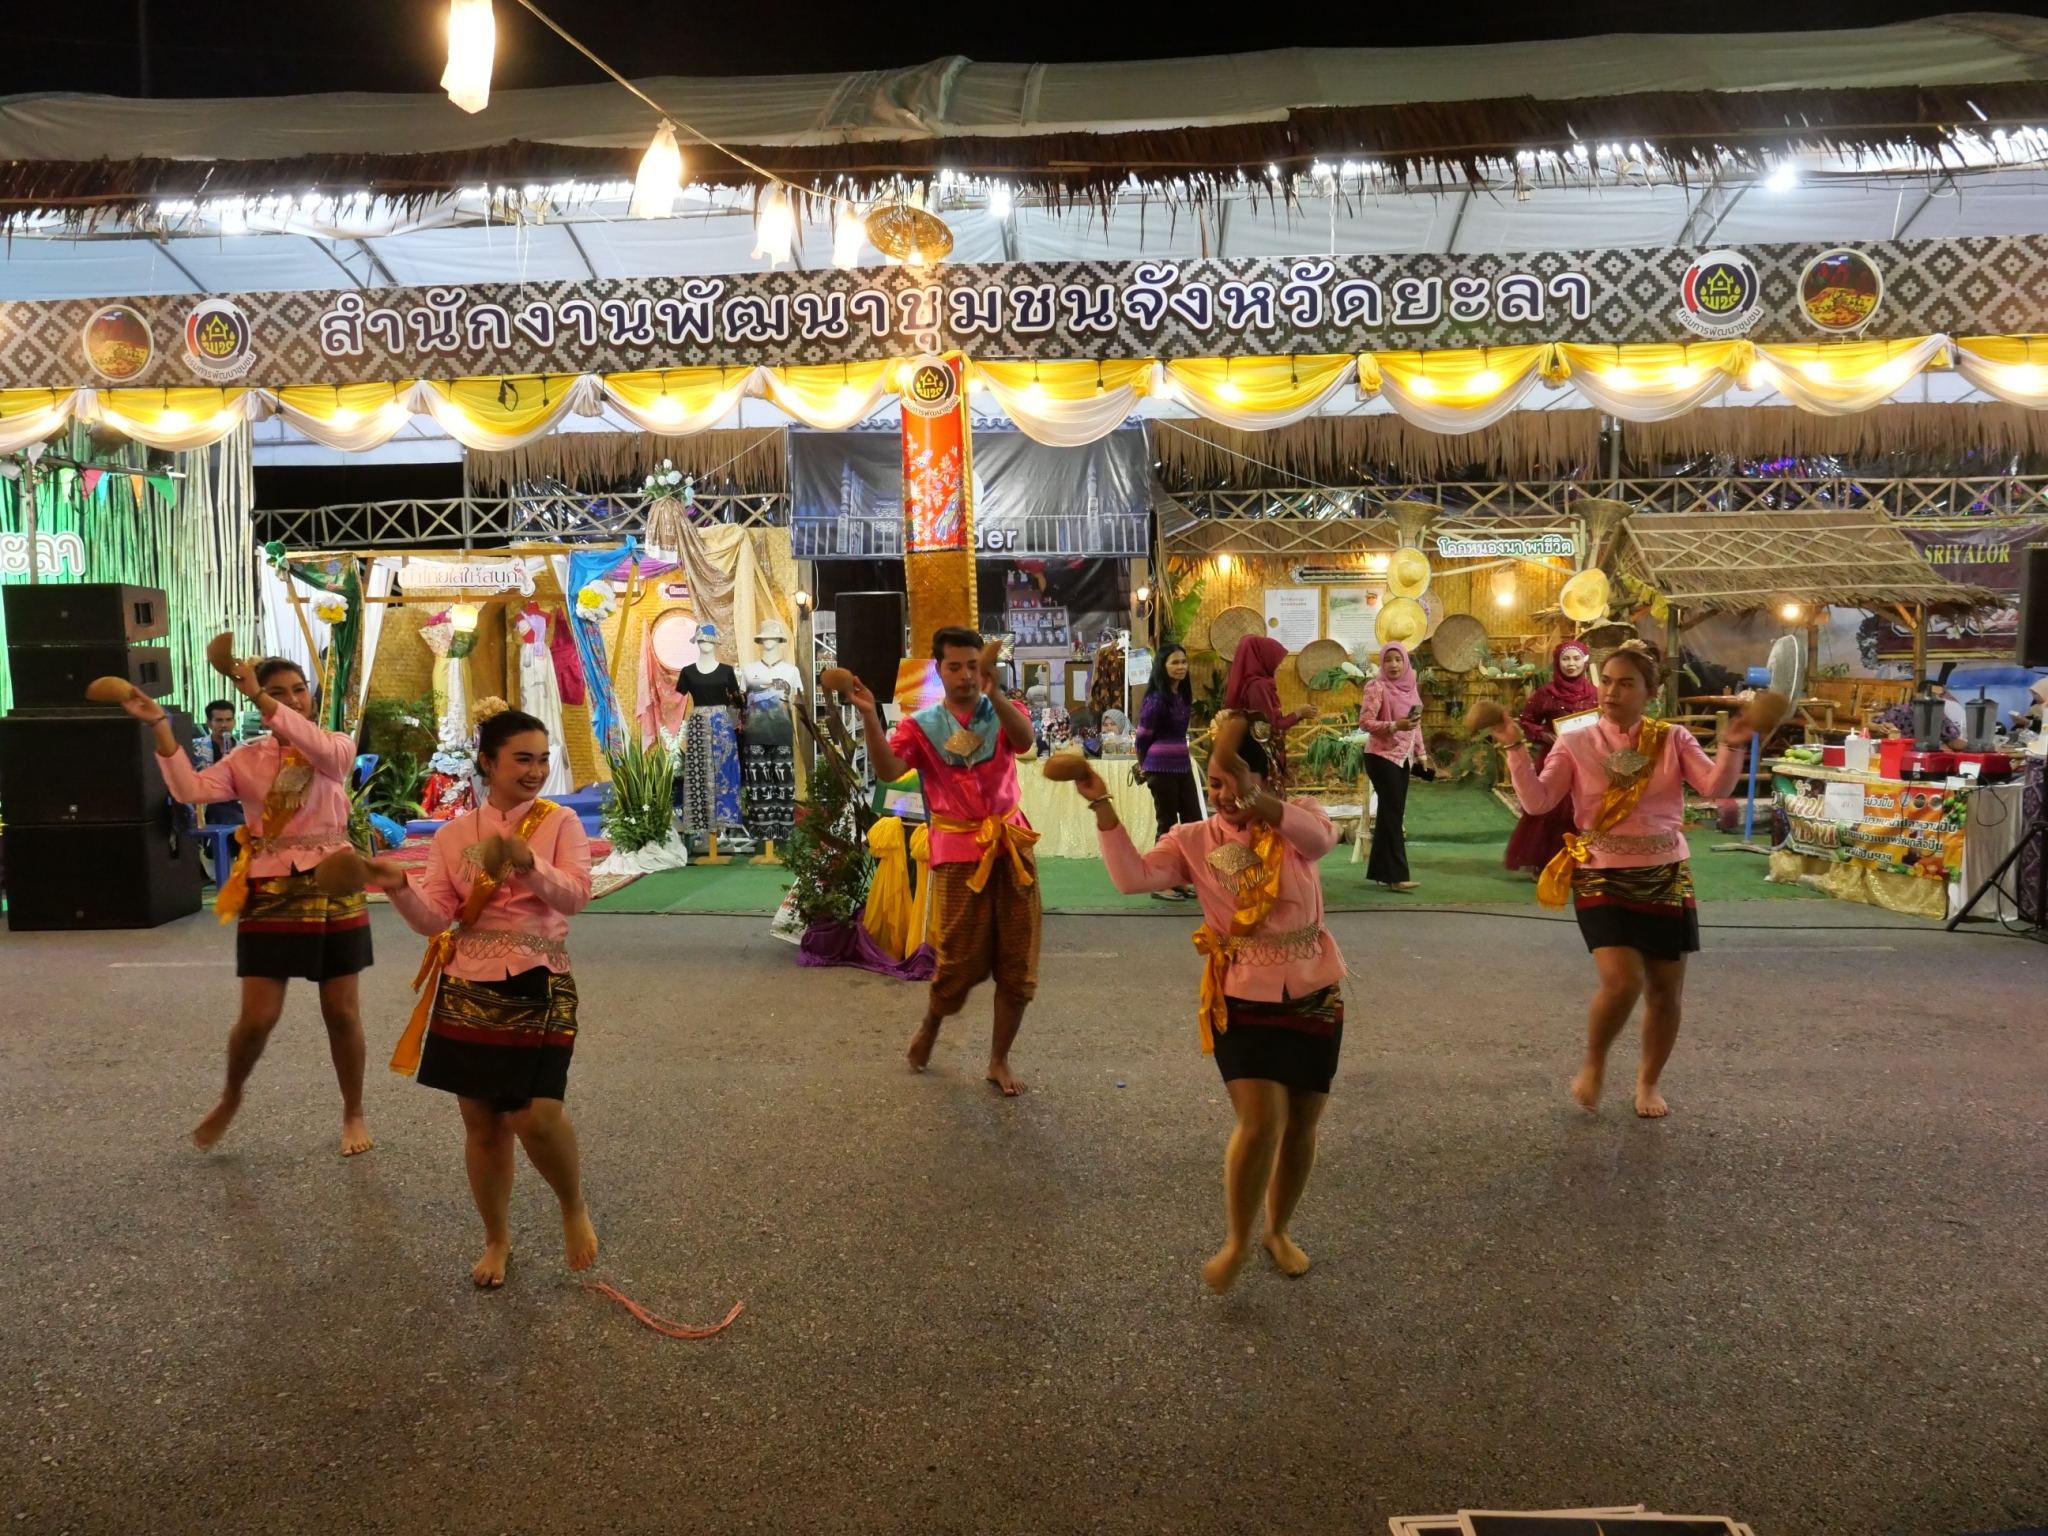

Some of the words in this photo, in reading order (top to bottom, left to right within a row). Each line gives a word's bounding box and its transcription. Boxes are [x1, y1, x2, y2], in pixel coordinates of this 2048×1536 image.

[320, 260, 1591, 355] สำนักงานพัฒนาชุมชนจังหวัดยะลา
[1678, 307, 1761, 337] กรมการพัฒนาชุมชน
[184, 353, 255, 380] กรมการพัฒนาชุมชน
[1438, 538, 1523, 556] โคกหนองนา
[1525, 535, 1573, 556] พาชีวิต
[1924, 543, 2011, 564] SRIYALOR
